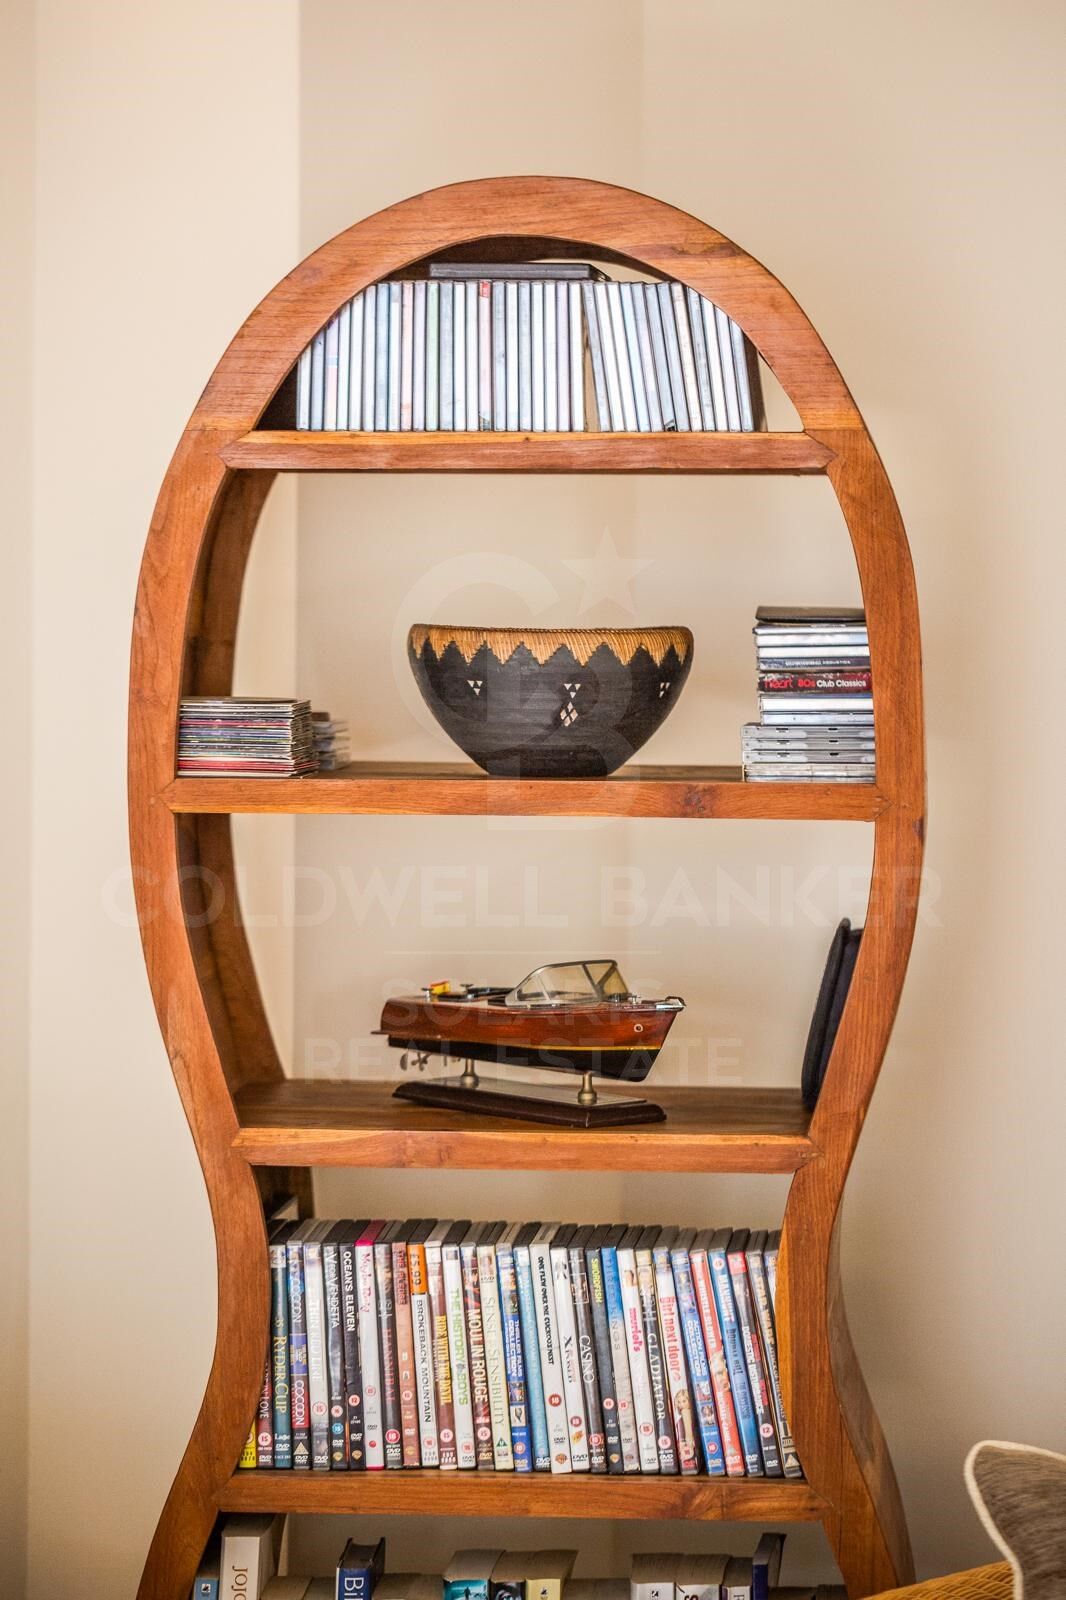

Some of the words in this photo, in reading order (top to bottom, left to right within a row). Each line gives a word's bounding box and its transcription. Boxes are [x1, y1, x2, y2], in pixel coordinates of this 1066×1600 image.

[816, 680, 834, 688] Club
[835, 680, 866, 688] Classics
[343, 1251, 353, 1292] OCEAN'S
[591, 1258, 603, 1304] SWORDFISH
[327, 1277, 340, 1329] VENDETTA
[346, 1294, 355, 1331] ELEVEN
[452, 1288, 461, 1311] THE
[417, 1300, 427, 1364] BROKEBACK
[435, 1316, 447, 1337] RIDE
[452, 1312, 465, 1362] HISTORY
[468, 1309, 484, 1357] MOULIN
[509, 1320, 518, 1377] COLLECTION
[609, 1304, 621, 1350] KINGS
[663, 1318, 679, 1344] next
[688, 1320, 702, 1377] COLLECTION
[742, 1326, 757, 1364] DOMESTIC
[274, 1336, 287, 1383] RYDER
[312, 1356, 322, 1381] LINE
[384, 1327, 395, 1403] HANNIBAL
[547, 1349, 555, 1365] NEST
[580, 1335, 594, 1383] CASINO
[648, 1333, 666, 1421] GLADIATOR
[667, 1344, 680, 1372] door
[275, 1383, 289, 1413] CUP
[294, 1379, 305, 1426] COCOON
[421, 1368, 431, 1423] MOUNTAIN
[457, 1374, 468, 1405] BOYS
[472, 1359, 488, 1403] ROUGE
[488, 1347, 504, 1425] SENSIBILITY
